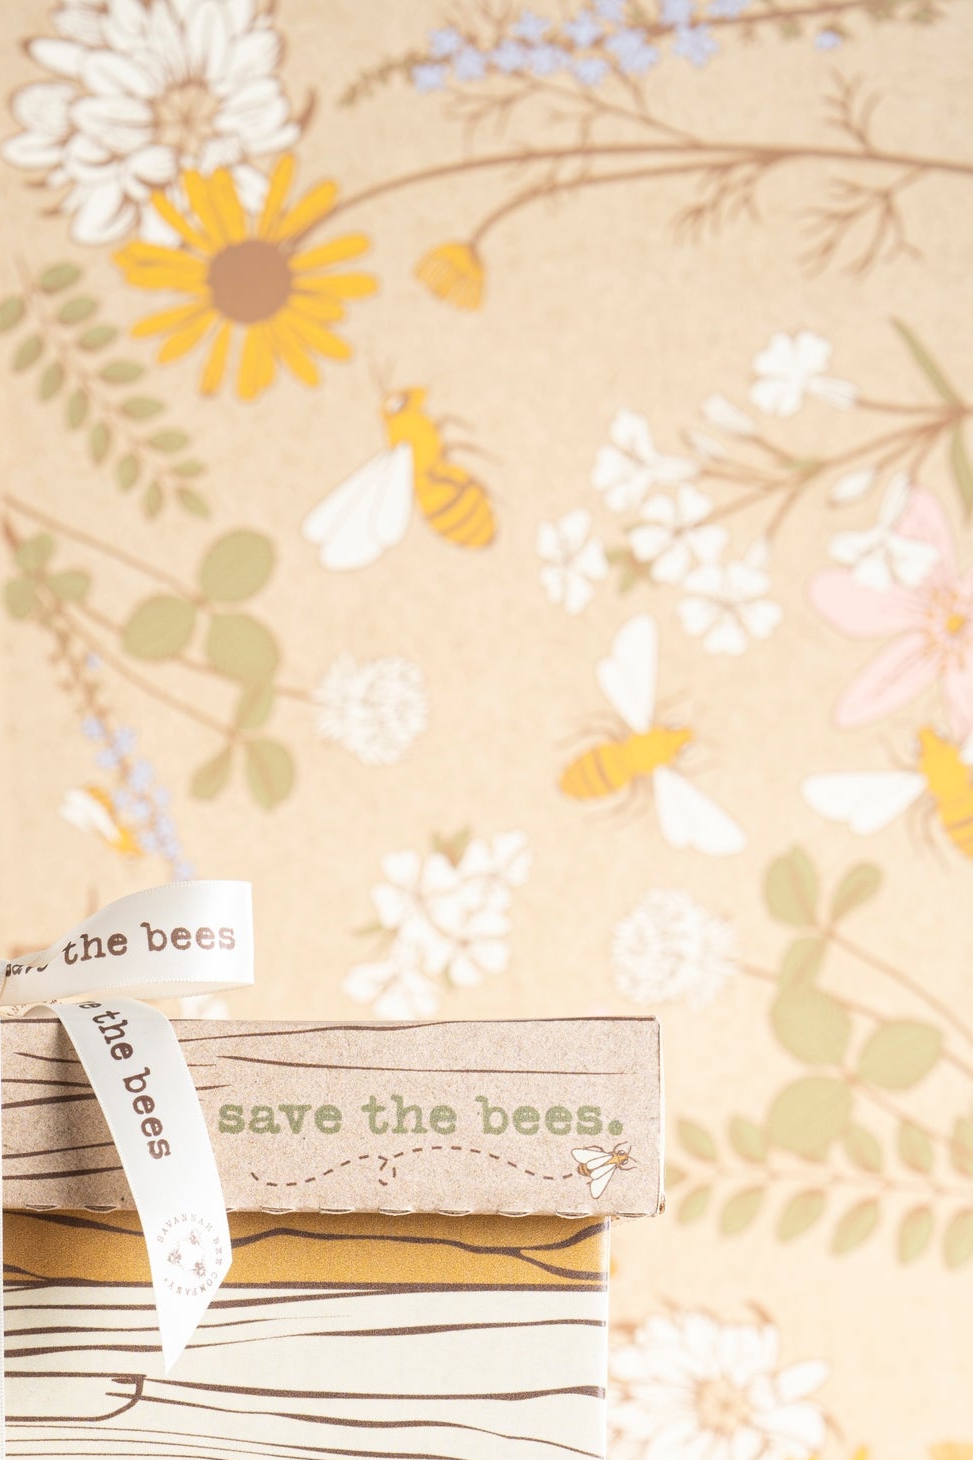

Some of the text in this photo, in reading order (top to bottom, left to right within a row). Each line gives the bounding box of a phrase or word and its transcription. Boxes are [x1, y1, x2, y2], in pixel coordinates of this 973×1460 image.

[62, 922, 236, 965] the bees
[93, 1011, 170, 1160] the bees
[217, 1095, 624, 1136] save the bees.
